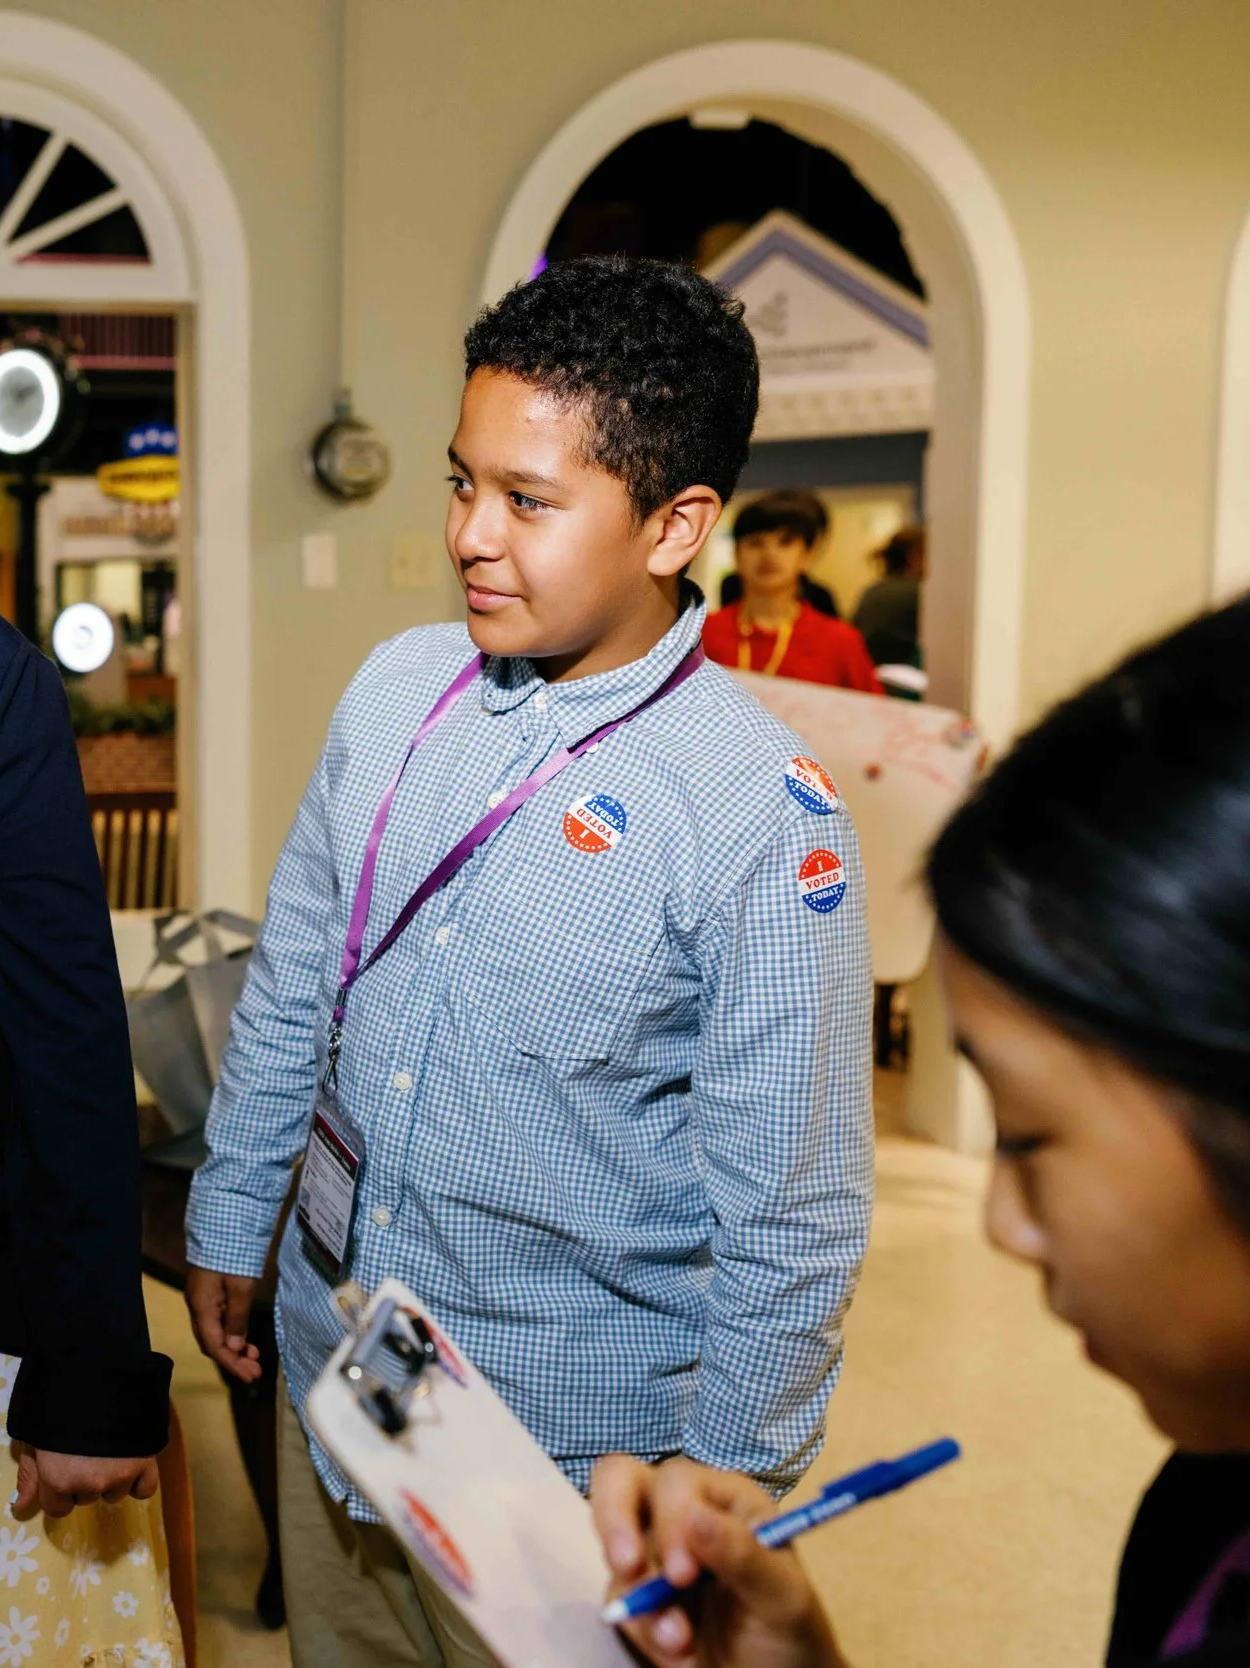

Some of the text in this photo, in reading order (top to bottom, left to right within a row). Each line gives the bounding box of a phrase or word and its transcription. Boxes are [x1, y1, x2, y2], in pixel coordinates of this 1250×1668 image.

[793, 781, 828, 806] TODAY
[795, 768, 833, 801] VOTD
[576, 808, 613, 839] VOTED
[588, 802, 619, 827] TODAY
[579, 829, 590, 839] I
[816, 860, 824, 872] I
[805, 872, 840, 890] VOTED
[811, 886, 840, 902] TODAY
